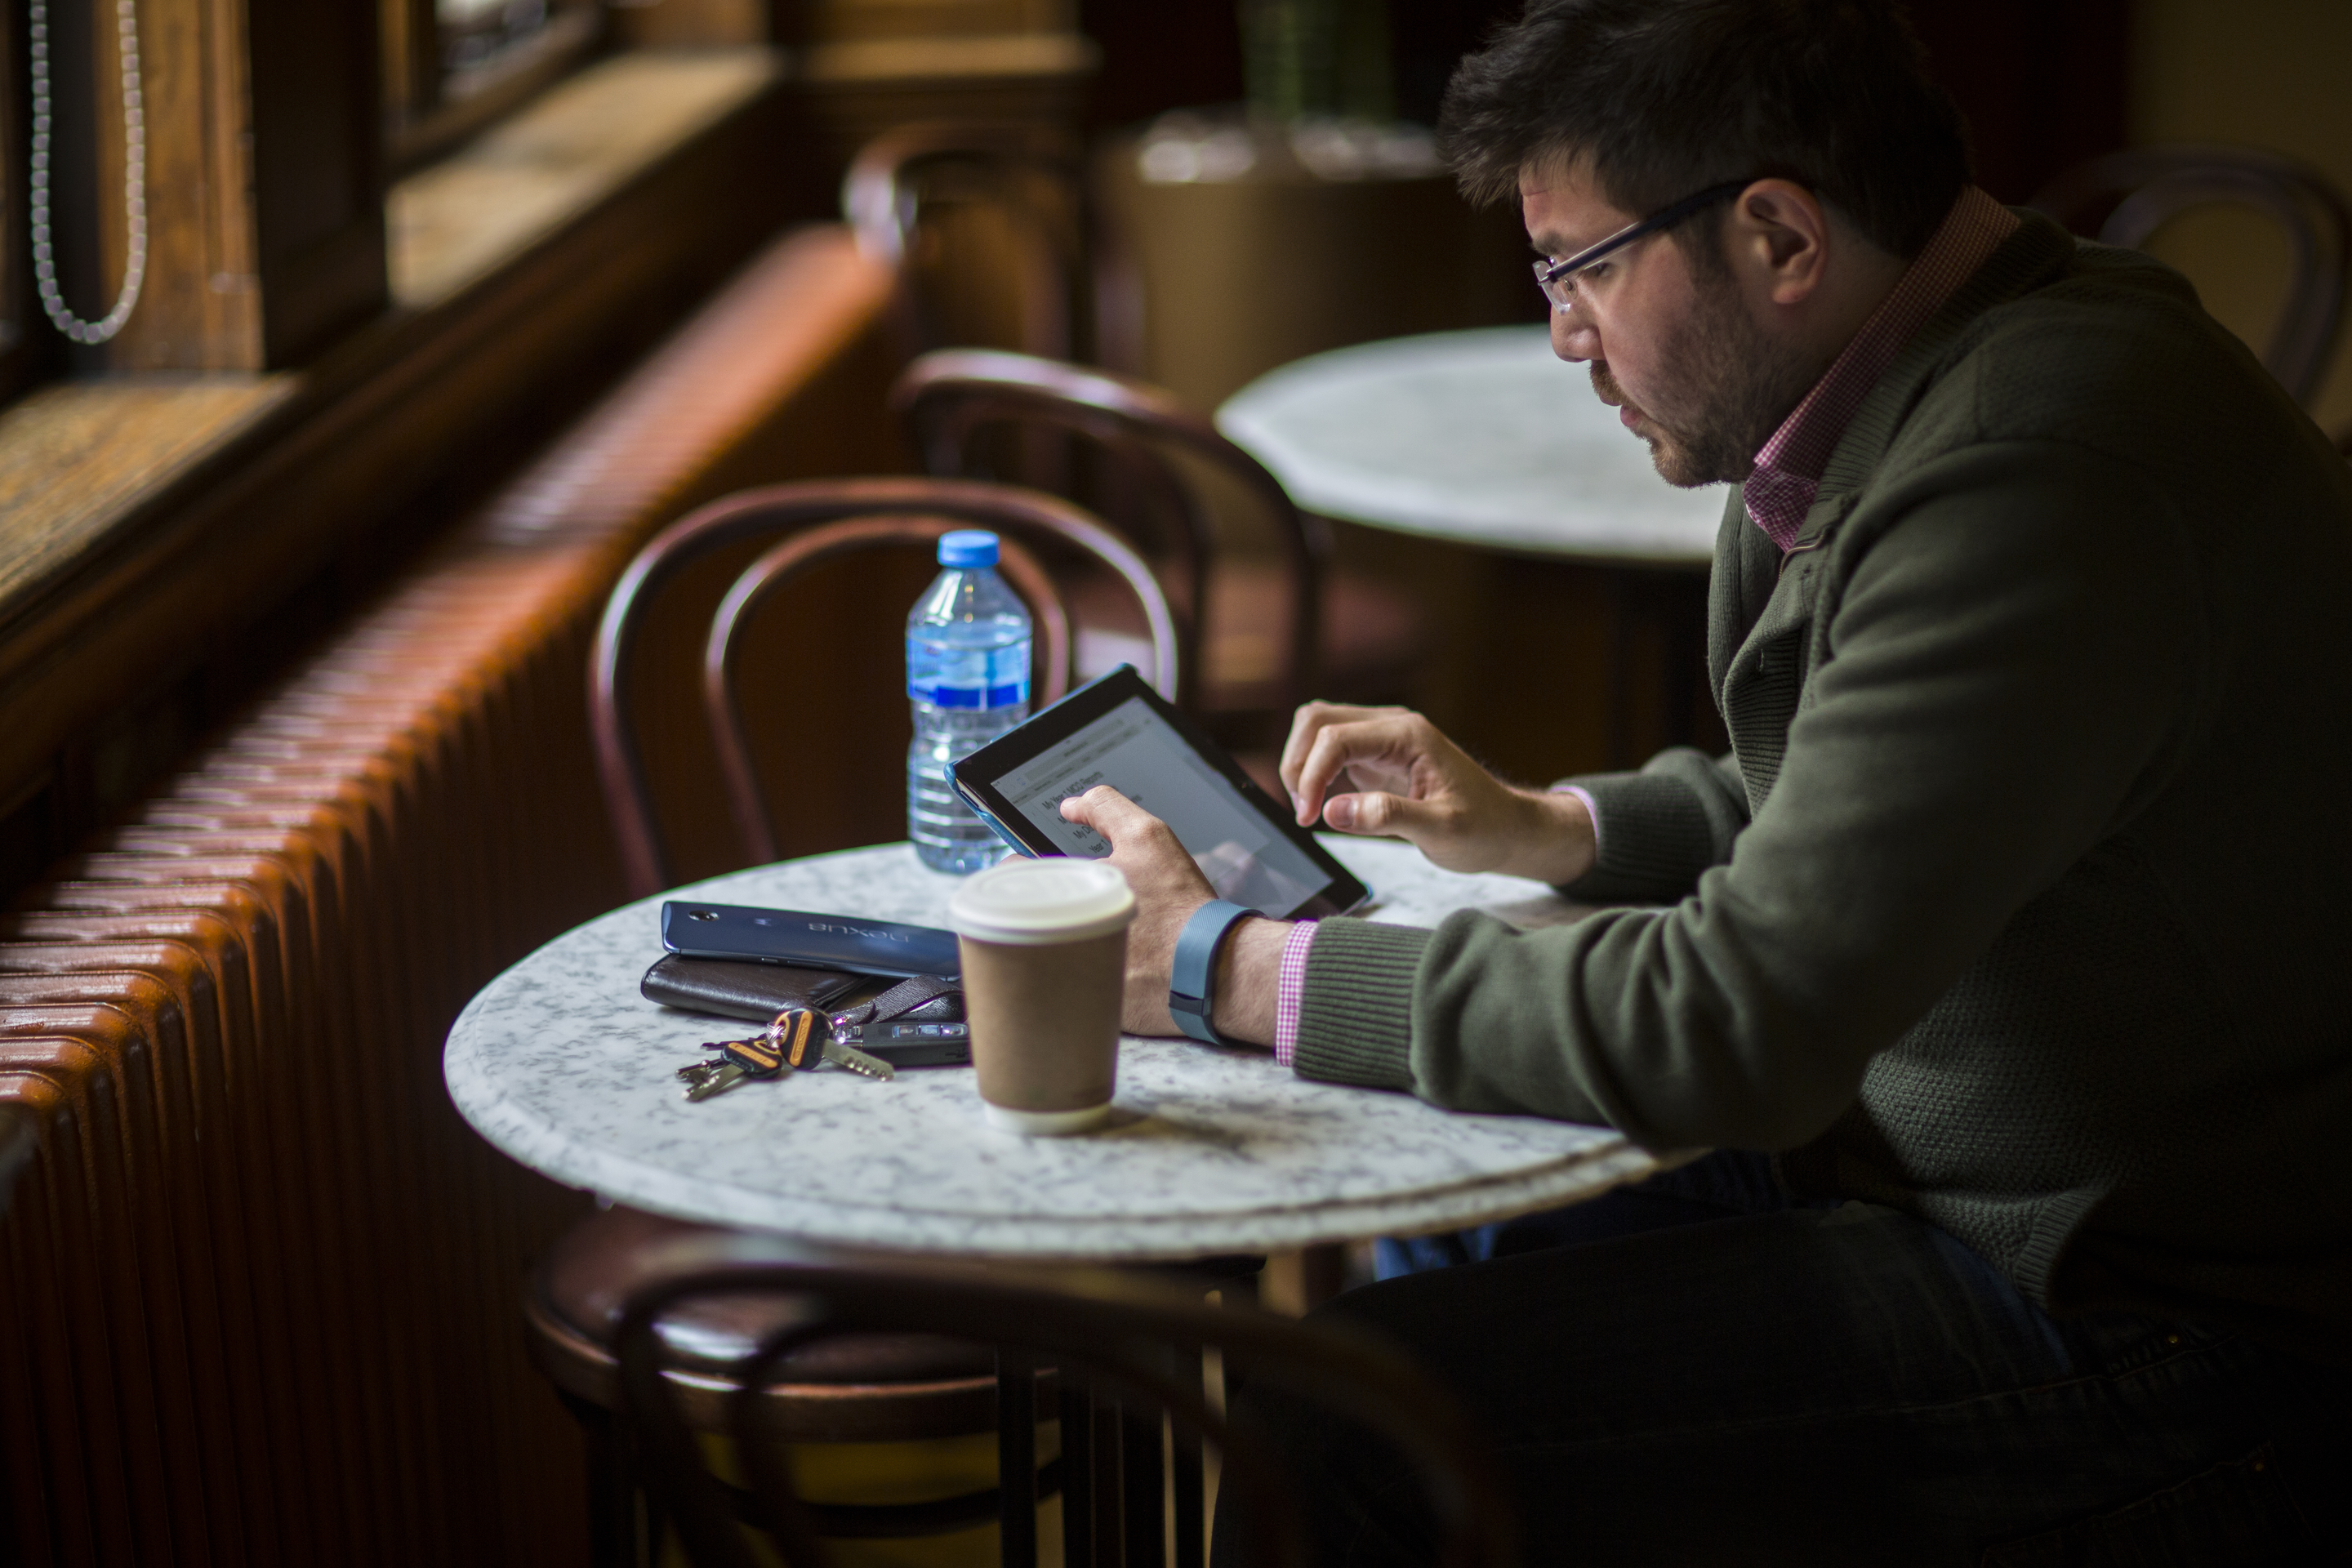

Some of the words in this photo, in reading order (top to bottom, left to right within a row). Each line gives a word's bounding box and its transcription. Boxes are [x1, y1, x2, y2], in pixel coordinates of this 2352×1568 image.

[1041, 801, 1056, 811] My
[1049, 794, 1064, 804] Year
[1072, 830, 1088, 840] My
[1089, 842, 1105, 853] Year
